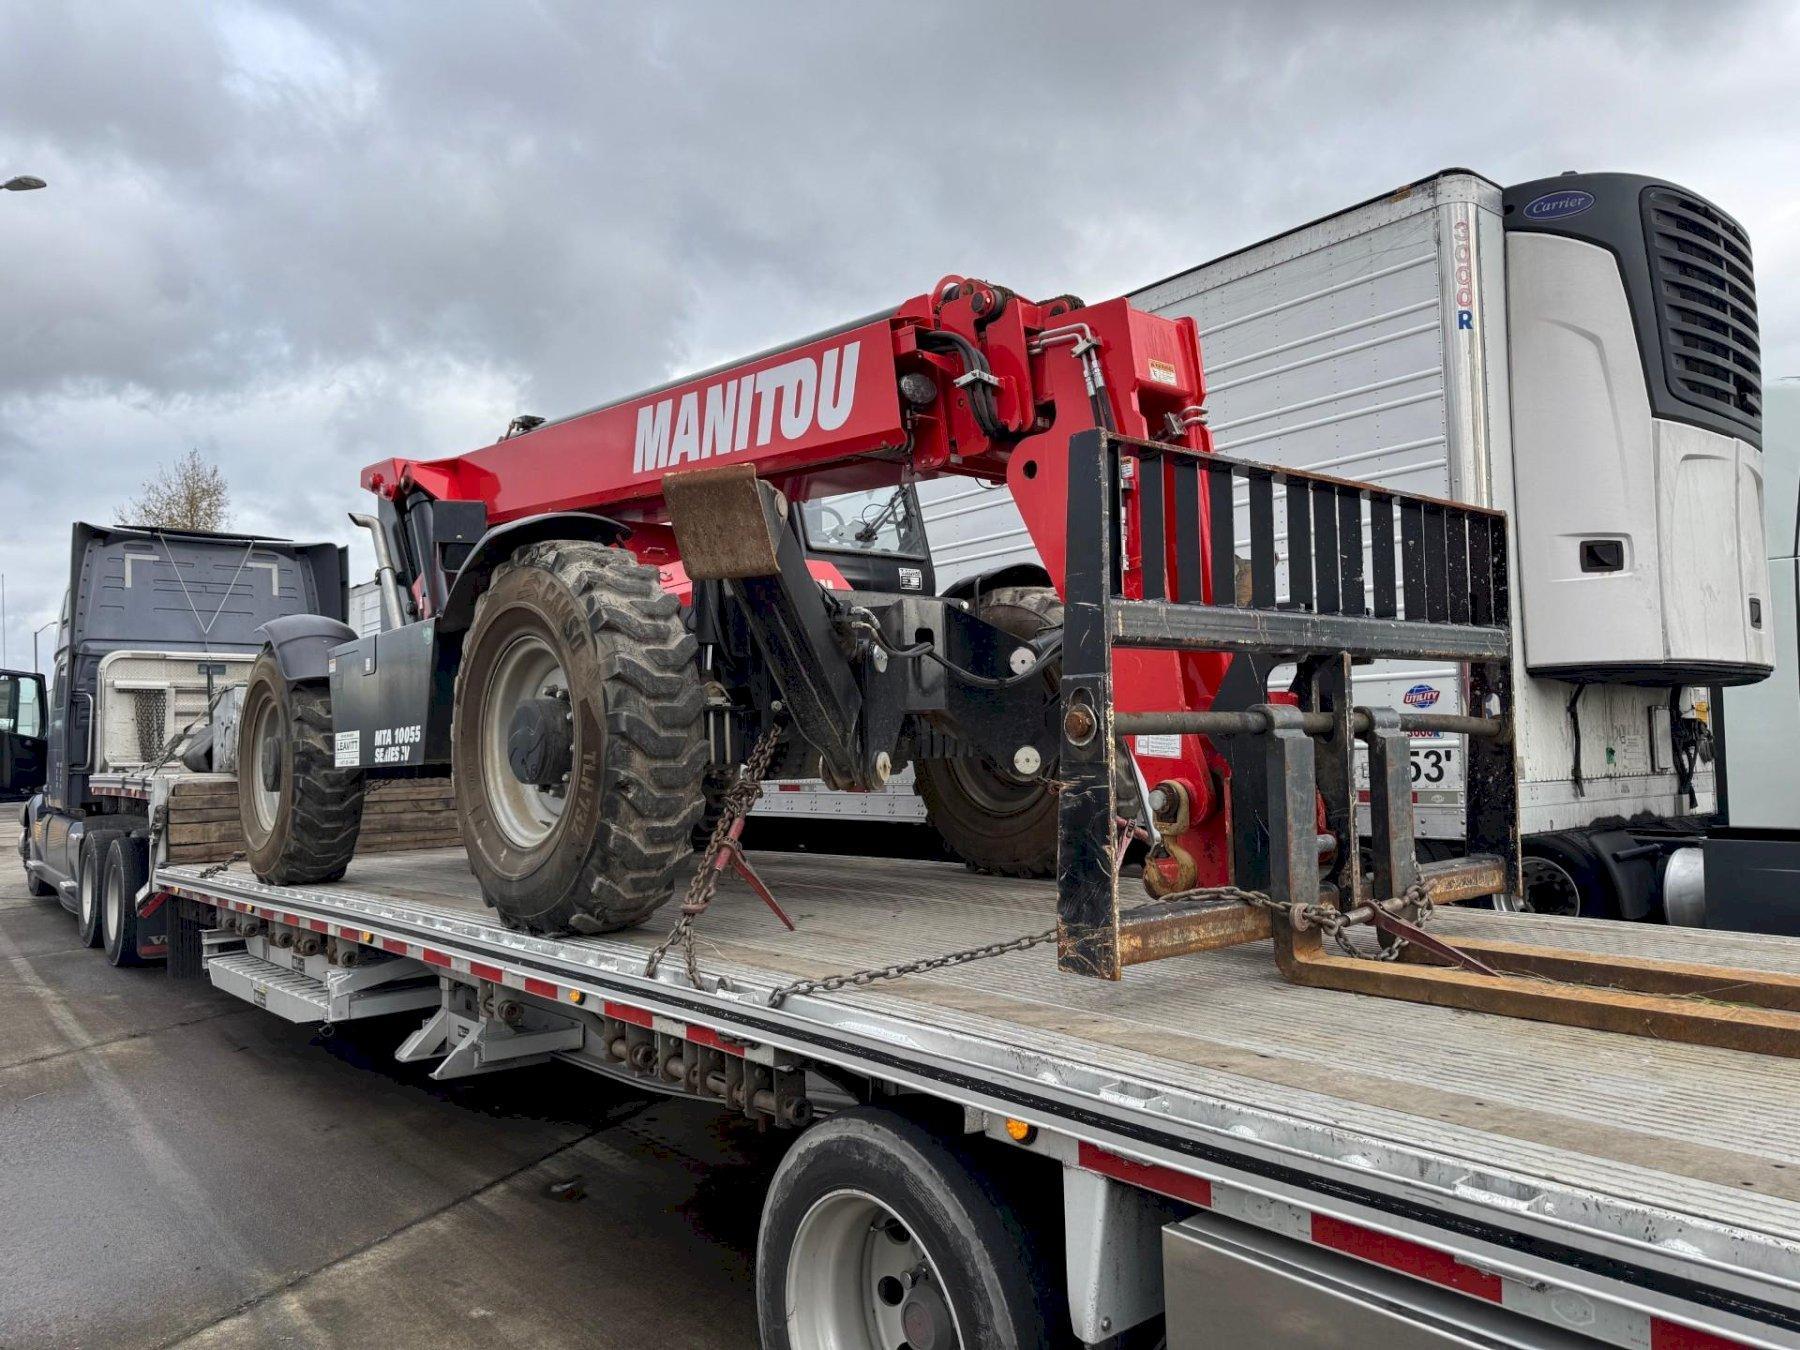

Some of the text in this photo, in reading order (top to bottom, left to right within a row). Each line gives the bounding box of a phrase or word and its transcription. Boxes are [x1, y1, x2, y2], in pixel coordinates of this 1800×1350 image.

[1532, 195, 1585, 214] Carrier
[633, 341, 861, 474] MANITOU
[1405, 691, 1439, 703] UTILITY
[375, 725, 421, 746] MTA 10055
[375, 746, 400, 763] SERIES
